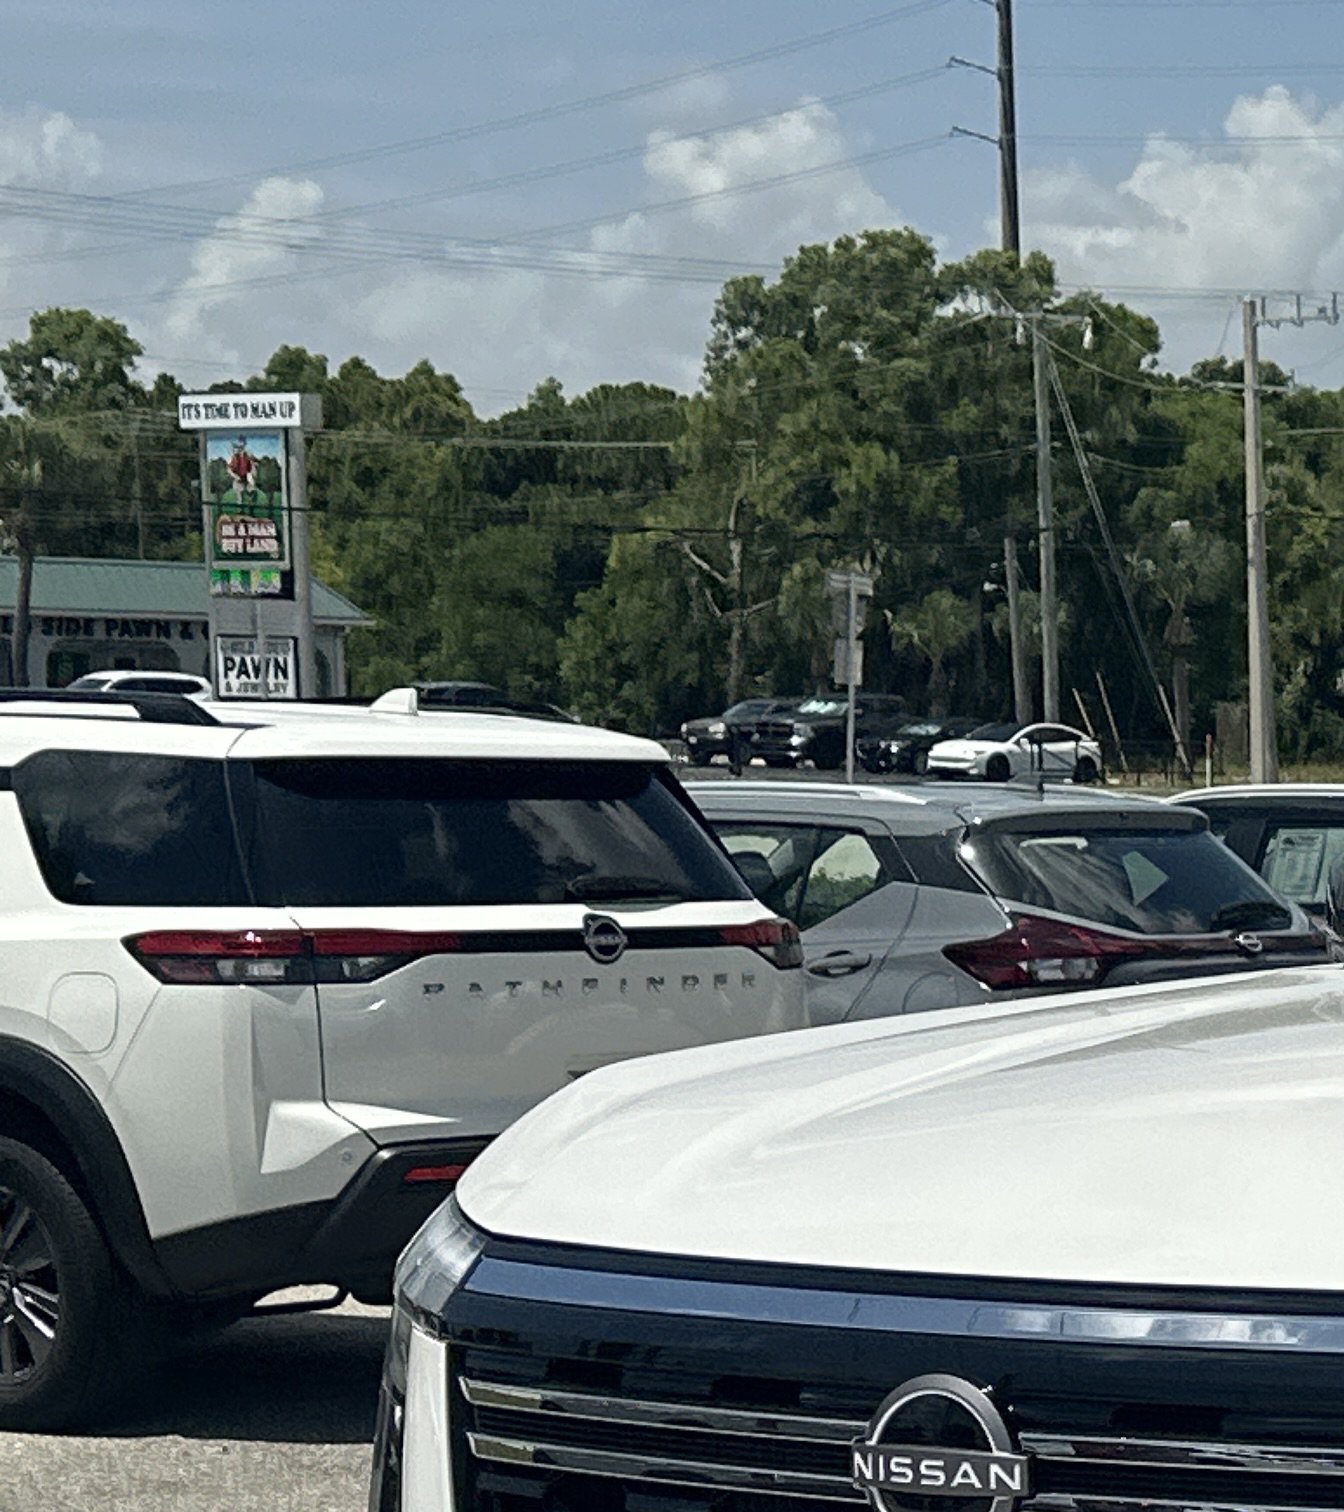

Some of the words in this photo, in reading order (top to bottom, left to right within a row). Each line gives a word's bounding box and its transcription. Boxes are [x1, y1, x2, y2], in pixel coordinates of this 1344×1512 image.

[203, 402, 230, 419] TIME
[232, 402, 248, 419] TO
[250, 401, 277, 418] MAN
[279, 401, 296, 418] UP
[104, 618, 171, 639] PAWN
[224, 656, 289, 680] PAWN
[422, 973, 757, 997] PATHFINDER
[853, 1452, 1021, 1491] NISSAN
